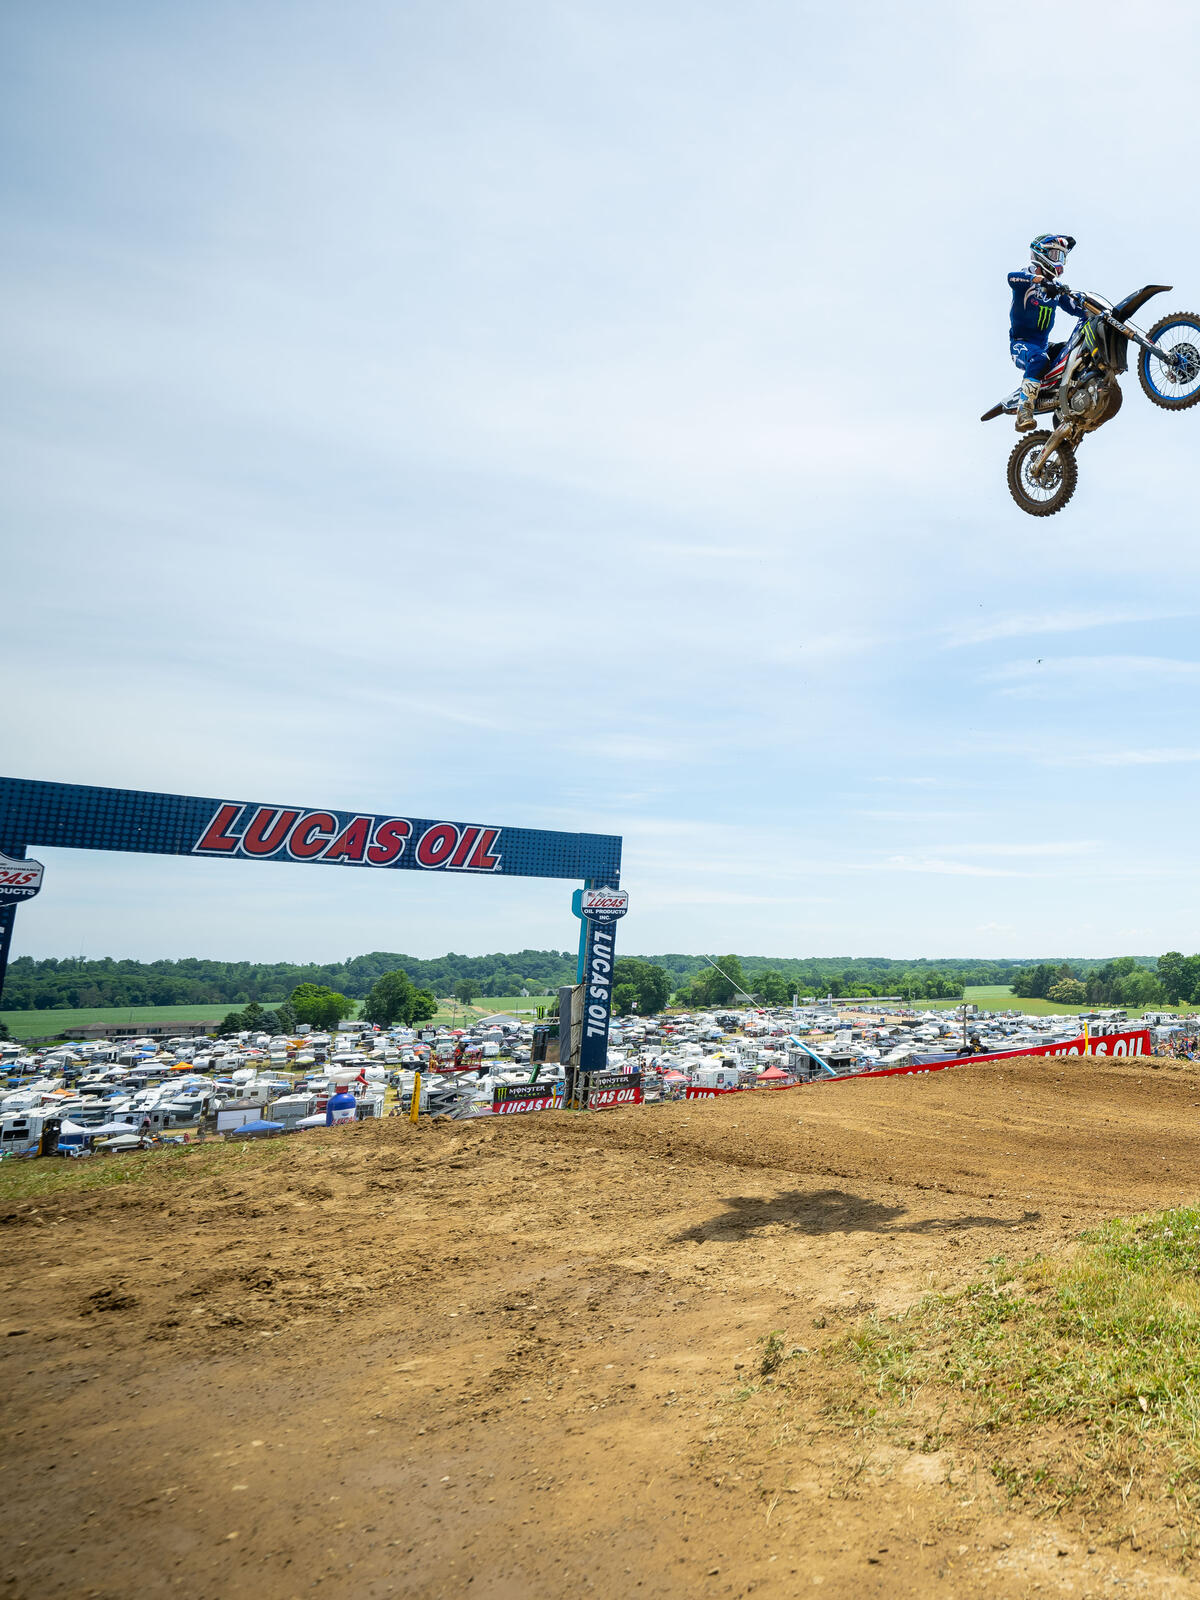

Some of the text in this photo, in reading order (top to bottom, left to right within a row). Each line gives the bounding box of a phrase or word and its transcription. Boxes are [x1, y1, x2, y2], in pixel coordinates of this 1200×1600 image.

[192, 802, 502, 871] LUCAS OIL
[587, 898, 626, 907] LUCAS
[587, 930, 612, 1037] LUCAS OIL
[509, 1085, 545, 1094] MONSTER
[617, 1089, 635, 1102] OIL
[499, 1100, 543, 1114] LUCAS
